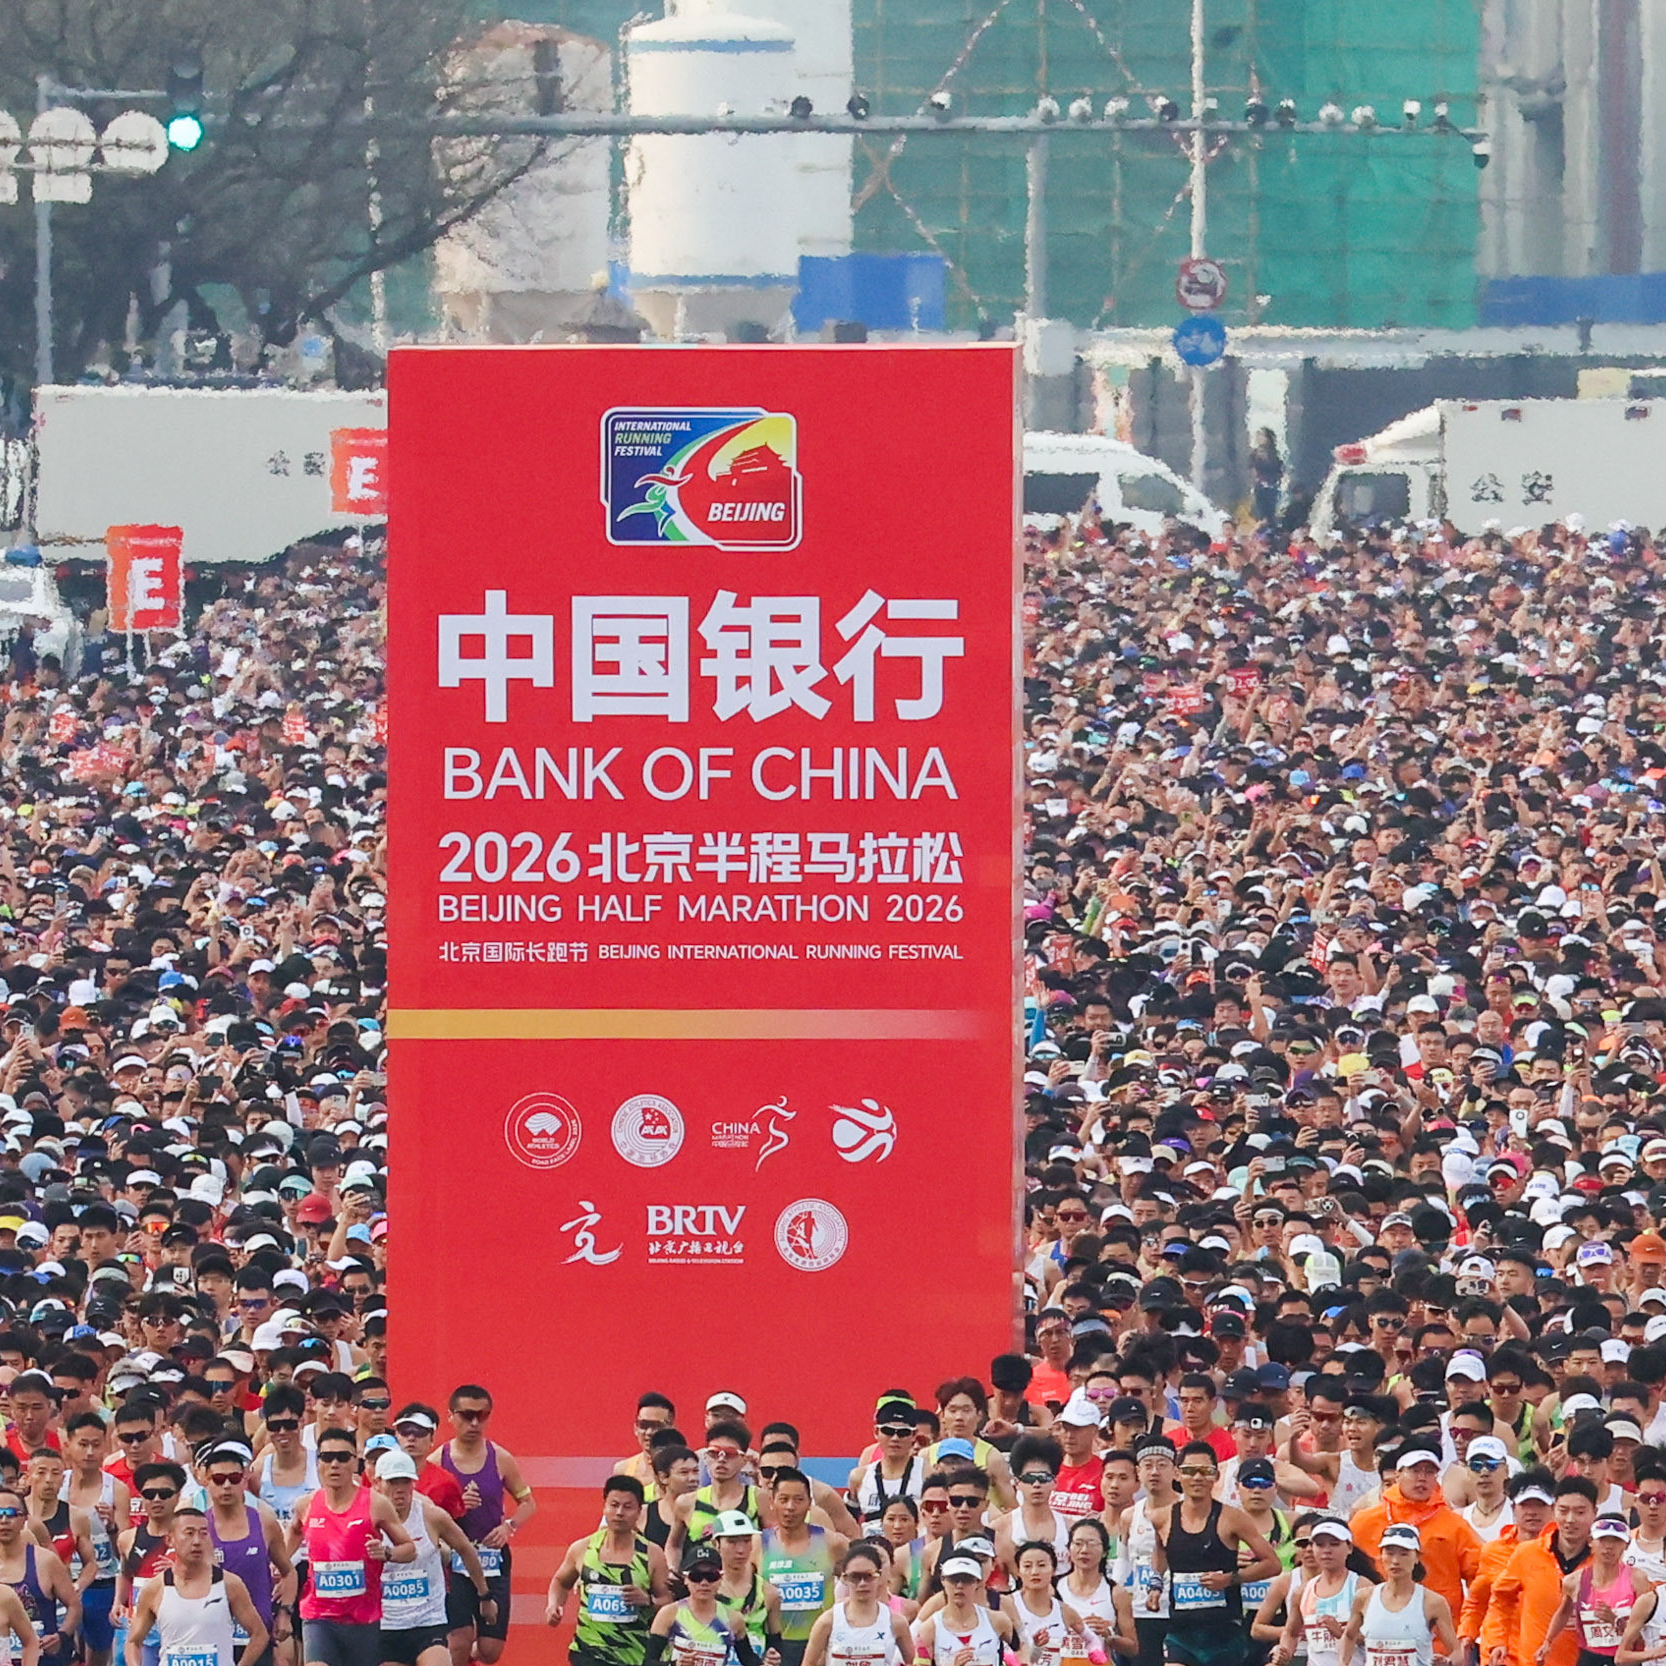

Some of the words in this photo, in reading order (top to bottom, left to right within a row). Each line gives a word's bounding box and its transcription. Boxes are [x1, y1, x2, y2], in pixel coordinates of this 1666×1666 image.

[615, 421, 691, 432] INTERNATIONAL
[615, 433, 671, 444] RUNNING
[615, 446, 662, 456] FESTIVAL
[346, 456, 380, 500] E
[1470, 470, 1554, 507] 公安
[707, 502, 786, 523] BEIJING
[130, 557, 166, 611] E
[437, 588, 965, 724] 中国银行
[443, 746, 624, 801] BANK
[642, 746, 733, 801] OF
[751, 746, 959, 801] CHINA
[438, 830, 964, 885] 2026北京半程马拉松
[438, 894, 562, 923] BEIJING
[578, 894, 662, 923] HALF
[678, 894, 870, 923] MARATHON
[886, 894, 964, 923] 2026
[438, 941, 589, 963] 北京国际长跑节
[598, 944, 660, 960] BEIJING
[667, 944, 800, 961] INTERNATIONAL
[806, 944, 882, 960] RUNNING
[888, 944, 963, 960] FESTIVAL
[711, 1121, 761, 1135] CHINA
[646, 1205, 746, 1236] BRTV
[1067, 1500, 1093, 1510] JING
[1070, 1493, 1090, 1501] BEI
[318, 1572, 360, 1587] A0301
[382, 1580, 425, 1597] A0085
[777, 1584, 821, 1602] A0035
